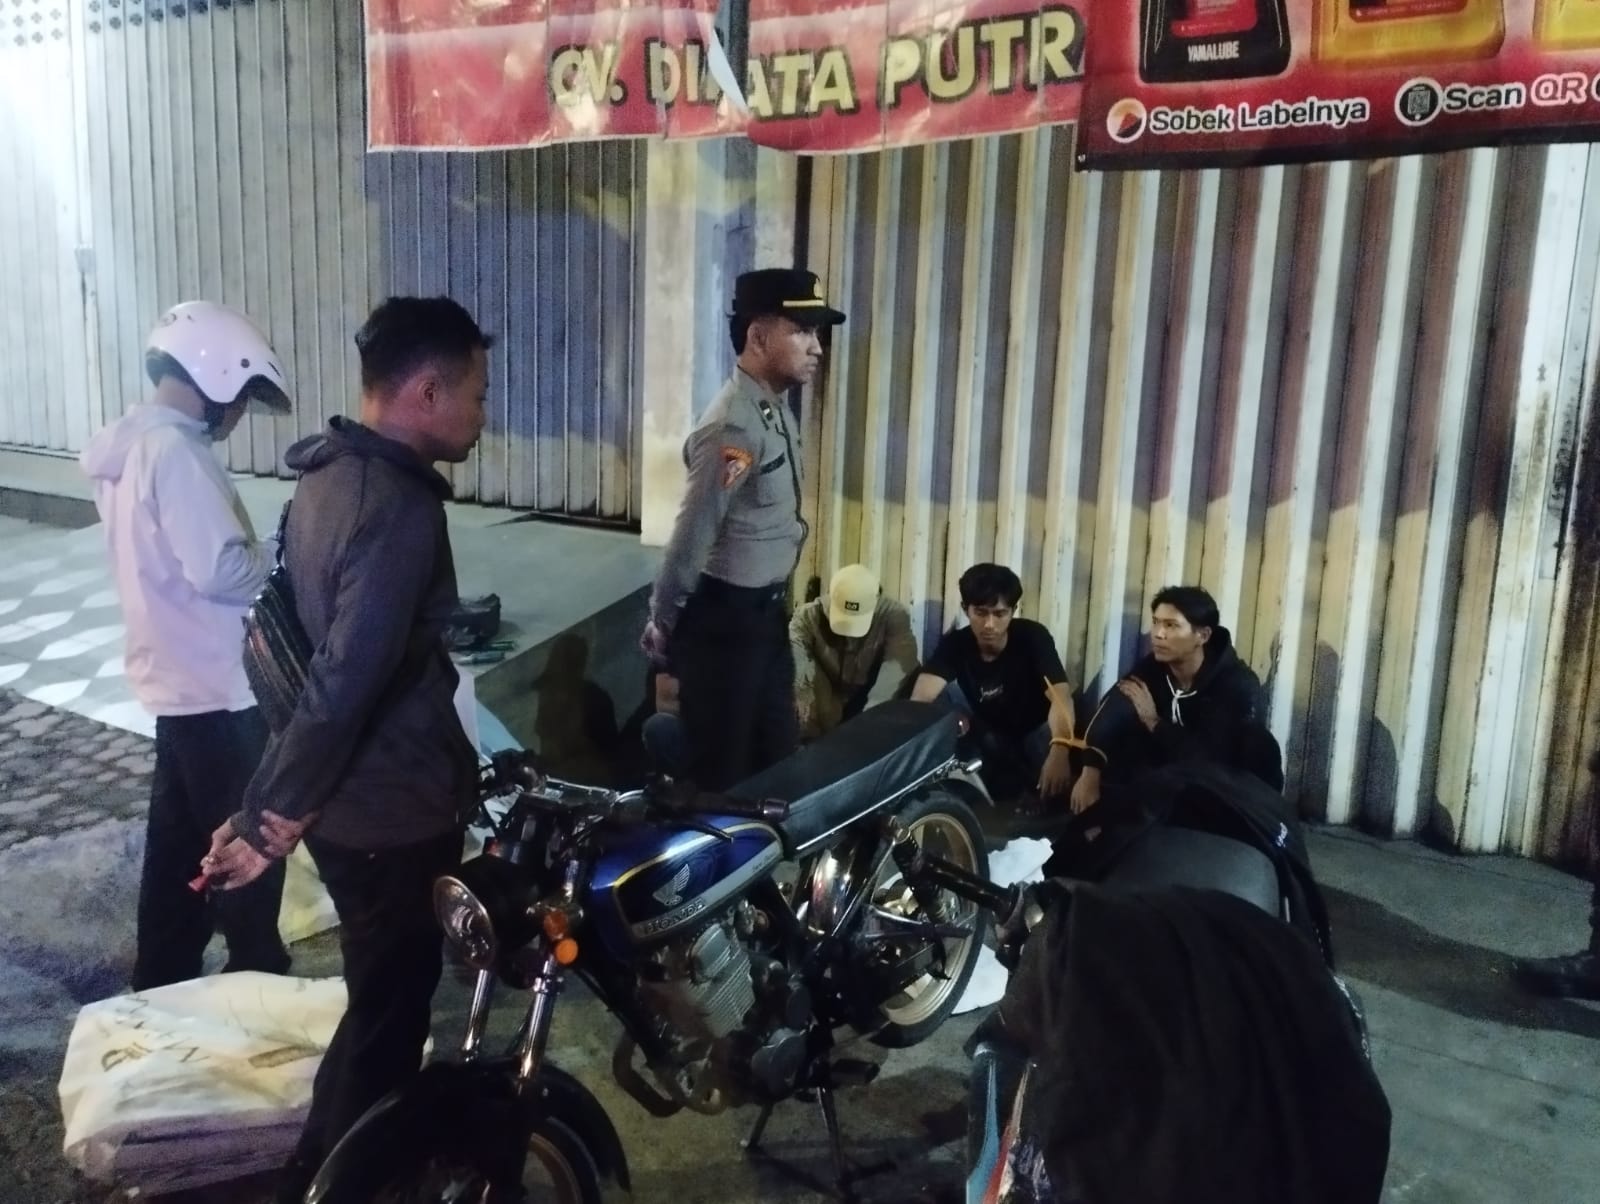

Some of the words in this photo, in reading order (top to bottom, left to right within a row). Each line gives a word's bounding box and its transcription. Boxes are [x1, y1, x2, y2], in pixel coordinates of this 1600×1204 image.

[551, 44, 626, 105] CV.
[882, 8, 1083, 106] PUTR
[1187, 39, 1240, 63] YAMALUBE
[1445, 84, 1523, 111] Scan
[1532, 74, 1586, 104] QR
[1151, 105, 1233, 133] Sobek
[1239, 98, 1368, 129] Labelnya
